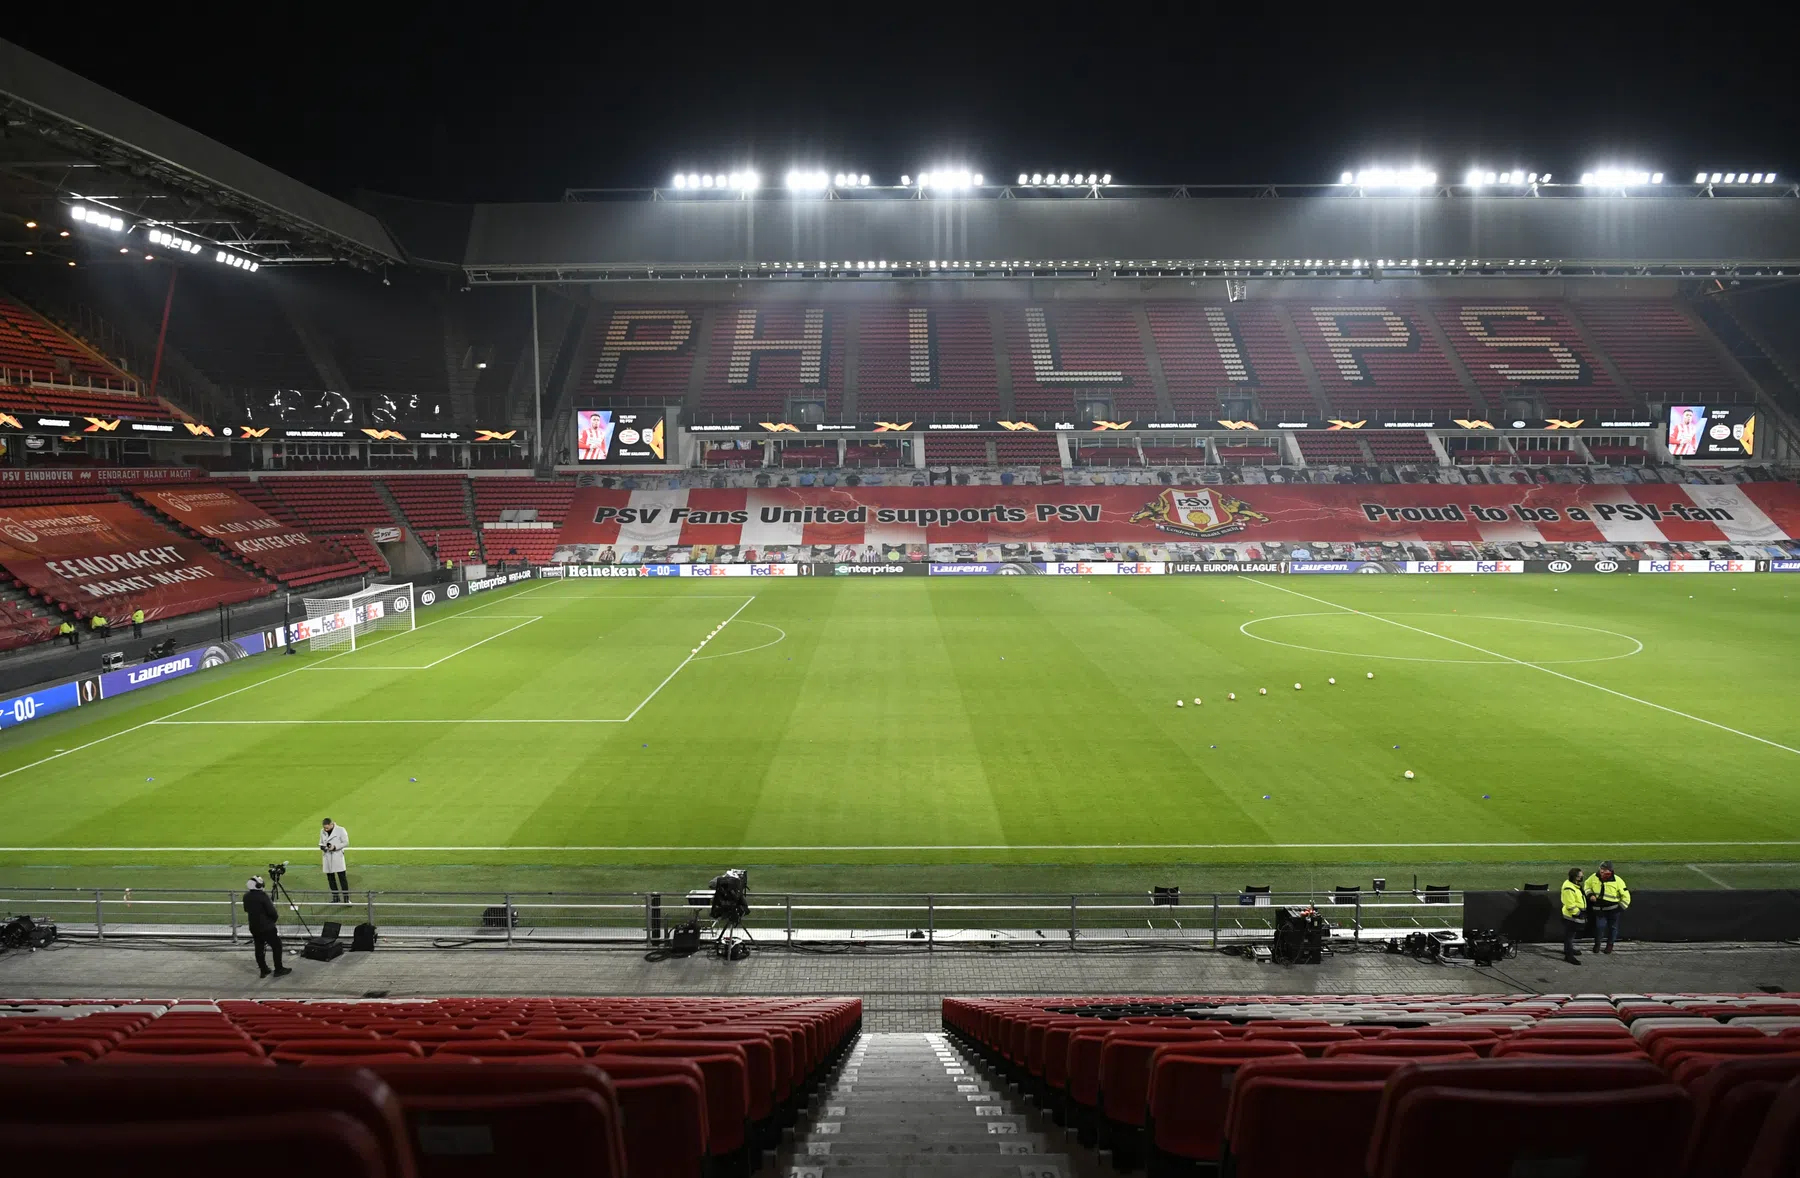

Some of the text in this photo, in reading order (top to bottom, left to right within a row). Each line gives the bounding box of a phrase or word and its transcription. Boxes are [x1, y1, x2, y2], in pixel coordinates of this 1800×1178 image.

[593, 306, 1580, 384] PHILIPS
[2, 470, 191, 480] PSV EINDHOVEN EENDRACHT MAAKT MACHT
[1177, 498, 1209, 506] PSV
[595, 504, 1100, 527] PSV Fans United supports PSV
[1362, 503, 1734, 522] Proud to be a PSV-fan
[23, 515, 100, 528] SUPPORTERS
[220, 522, 246, 533] 100
[247, 518, 282, 530] JAAR
[234, 532, 312, 553] ACHTER PSV
[45, 546, 186, 578] EENDRACHT
[1117, 563, 1152, 573] FedEx
[1177, 564, 1277, 572] UEFA EUROPA LEAGUE
[1418, 562, 1452, 572] FedEx
[1476, 562, 1511, 572] FedEx
[1650, 561, 1685, 572] FedEx
[1709, 561, 1743, 571] FedEx
[568, 565, 637, 577] Heineken
[691, 564, 726, 576] FedEx
[750, 564, 785, 575] FedEx
[838, 564, 904, 575] enterprise
[1058, 564, 1093, 574] FedEx
[80, 566, 215, 597] MAAKT MACHT
[471, 575, 507, 591] enterprise
[356, 603, 378, 622] FedEx
[322, 613, 346, 632] FedEx
